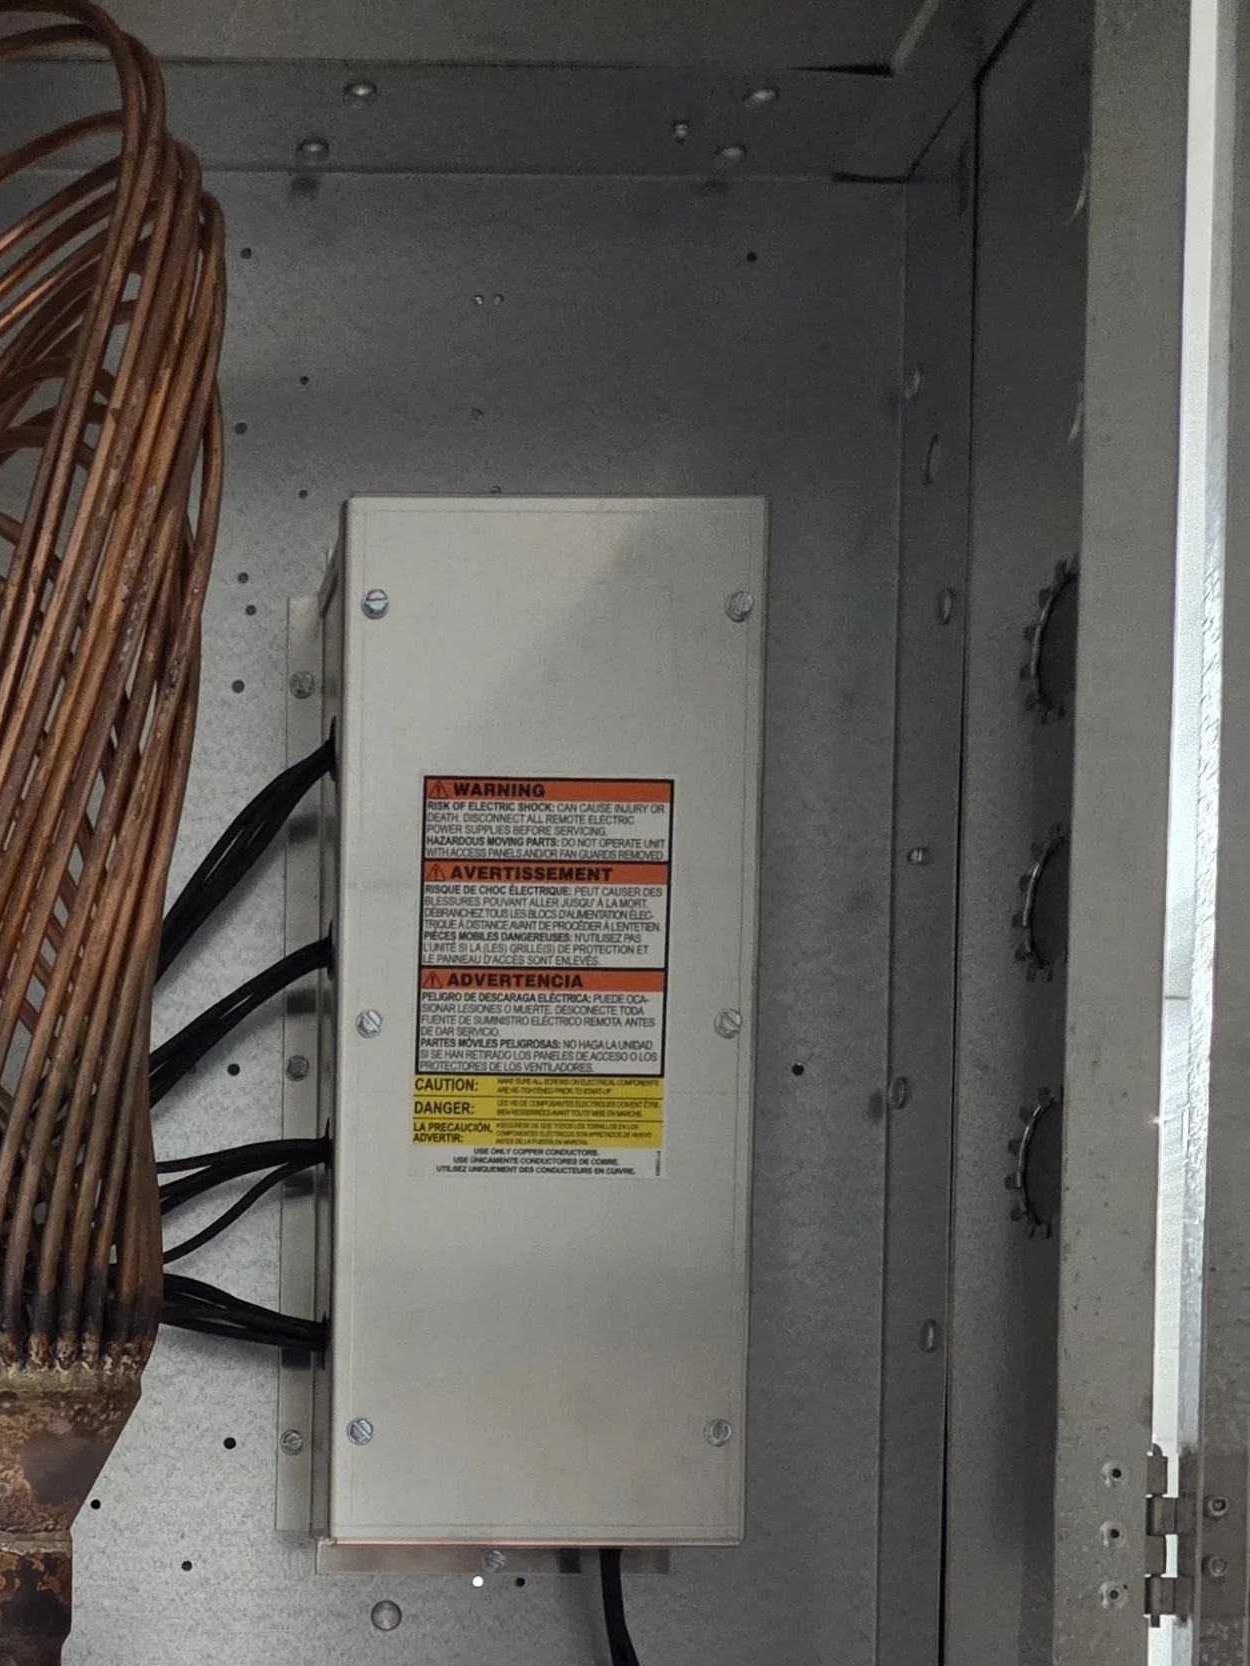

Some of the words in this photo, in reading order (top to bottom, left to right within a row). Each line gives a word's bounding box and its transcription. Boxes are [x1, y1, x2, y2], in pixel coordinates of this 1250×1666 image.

[453, 782, 545, 797] WARNING
[428, 801, 449, 810] RISK
[452, 801, 465, 810] OF
[468, 801, 515, 811] ELECTRIC
[517, 802, 555, 811] SHOCK:
[557, 803, 577, 812] CAN
[580, 803, 612, 812] CAUSE
[614, 804, 647, 813] INJURY
[650, 804, 664, 813] OR
[427, 812, 460, 822] DEATH.
[463, 813, 525, 823] DISCONNECT
[526, 814, 543, 823] ALL
[545, 814, 585, 824] REMOTE
[588, 815, 634, 824] ELECTRIC
[427, 824, 461, 834] POWER
[464, 824, 510, 834] SUPPLIES
[513, 825, 552, 835] BEFORE
[554, 826, 606, 836] SERVICING.
[426, 836, 484, 845] HAZARDOUS
[486, 836, 524, 846] MOVING
[526, 837, 559, 847] PARTS:
[561, 838, 574, 847] DO
[577, 838, 596, 847] NOT
[598, 838, 641, 848] OPERATE
[643, 839, 664, 848] UNIT
[425, 847, 449, 857] WITH
[450, 848, 487, 857] ACCESS
[488, 848, 522, 858] PANELS
[523, 849, 557, 858] AND/OR
[559, 849, 576, 858] FAN
[578, 850, 616, 859] GUARDS
[450, 865, 613, 881] AVERTISSEMENT
[425, 884, 461, 894] RISQUE
[463, 885, 475, 894] DE
[478, 885, 506, 894] CHOC
[508, 883, 572, 895] ÉLECTRIQUE:
[574, 886, 599, 896] PEUT
[601, 887, 641, 896] CAUSER
[643, 887, 662, 896] DES
[424, 896, 481, 905] BLESSURES
[483, 897, 527, 906] POUVANT
[529, 897, 558, 906] ALLER
[605, 898, 618, 907] LA
[424, 919, 456, 929] TRIQUE
[466, 920, 510, 929] DISTANCE
[510, 920, 537, 930] AVANT
[538, 921, 550, 930] DE
[458, 931, 498, 941] MOBILES
[500, 932, 572, 942] DANGEREUSES:
[574, 933, 621, 942] N'UTILISEZ
[623, 933, 642, 943] PAS
[457, 942, 467, 952] SI
[469, 943, 481, 952] LA
[483, 943, 507, 952] (LES)
[509, 943, 555, 953] GRILLE(S)
[557, 944, 570, 953] DE
[572, 944, 634, 954] PROTECTION
[636, 945, 648, 954] ET
[422, 954, 434, 963] LE
[436, 954, 481, 964] PANNEAU
[526, 955, 551, 965] SONT
[447, 972, 583, 988] ADVERTENCIA
[421, 992, 461, 1001] PELIGRO
[464, 992, 476, 1001] DE
[478, 992, 535, 1002] DESCARAGA
[537, 992, 591, 1003] ELÉCTRICA:
[592, 994, 623, 1003] PUEDE
[421, 1003, 455, 1013] SIONAR
[457, 1003, 502, 1013] LESIONES
[504, 1004, 511, 1013] O
[619, 1006, 644, 1015] TODA
[421, 1015, 455, 1024] FUENTE
[458, 1015, 471, 1024] DE
[473, 1015, 529, 1025] SUMINISTRO
[531, 1014, 581, 1025] ELÉCTRICO
[583, 1017, 622, 1026] REMOTA
[624, 1017, 655, 1026] ANTES
[420, 1026, 432, 1035] DE
[435, 1026, 455, 1035] DAR
[456, 1026, 500, 1036] SERVICIO.
[420, 1038, 456, 1047] PARTES
[457, 1036, 497, 1047] MÓVILES
[500, 1039, 561, 1048] PELIGROSAS:
[562, 1039, 577, 1048] NO
[578, 1040, 603, 1048] HAGA
[605, 1040, 617, 1049] LA
[618, 1040, 652, 1049] UNIDAD
[420, 1050, 429, 1058] SI
[430, 1050, 442, 1058] SE
[444, 1050, 464, 1059] HAN
[465, 1050, 511, 1059] RETIRADO
[513, 1051, 531, 1060] LOS
[532, 1051, 572, 1060] PANELES
[574, 1052, 588, 1060] DE
[589, 1052, 627, 1061] ACCESO
[629, 1052, 636, 1061] O
[638, 1052, 657, 1061] LOS
[419, 1061, 486, 1070] PROTECTORES
[489, 1062, 501, 1070] DE
[503, 1062, 522, 1071] LOS
[524, 1062, 594, 1072] VENTILADORES.
[415, 1079, 478, 1091] CAUTION:
[414, 1102, 474, 1115] DANGER:
[413, 1123, 426, 1131] LA
[429, 1122, 493, 1133] PRECAUCIÓN,
[413, 1133, 463, 1143] ADVERTIR:
